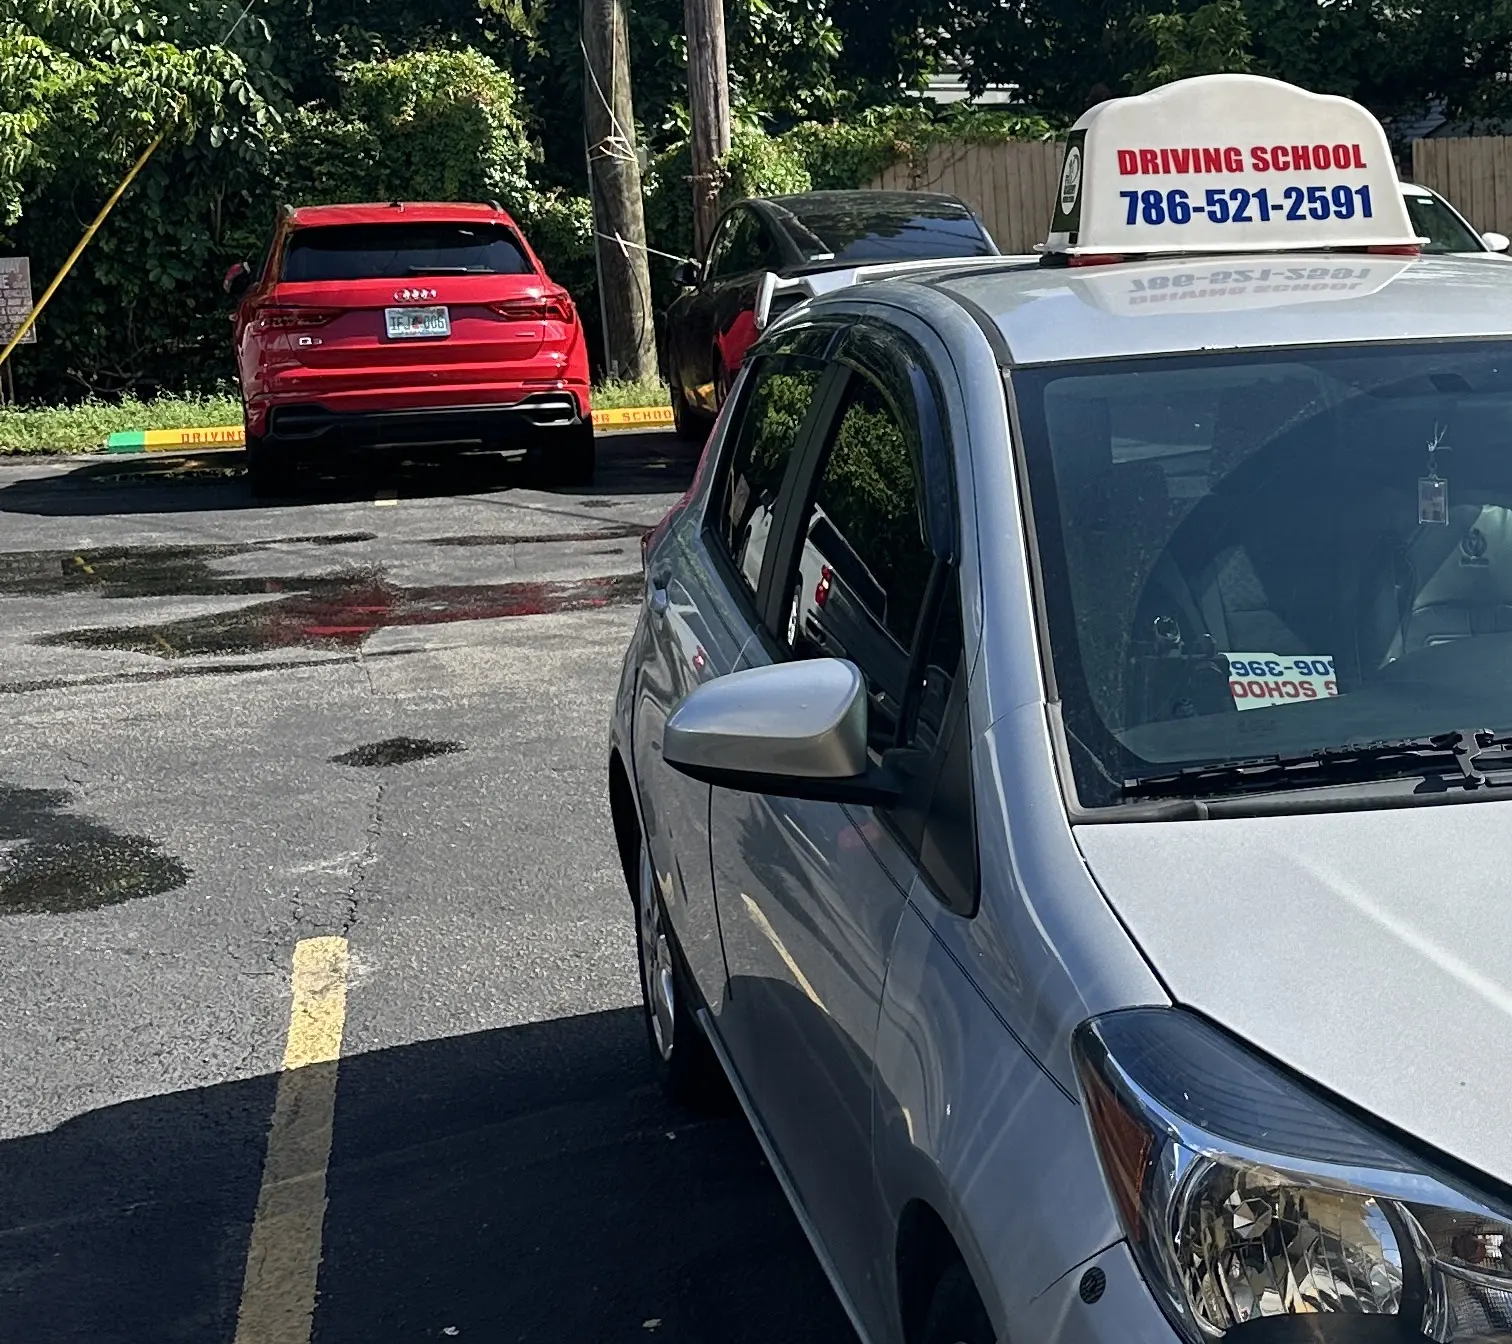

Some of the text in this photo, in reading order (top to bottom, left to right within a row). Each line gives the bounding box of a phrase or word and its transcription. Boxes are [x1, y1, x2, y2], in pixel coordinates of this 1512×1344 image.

[1117, 143, 1367, 175] DRIVING SCHOOL
[1120, 184, 1373, 226] 786-521-2591
[1229, 660, 1335, 677] 06-396
[1229, 680, 1318, 699] SCHOO
